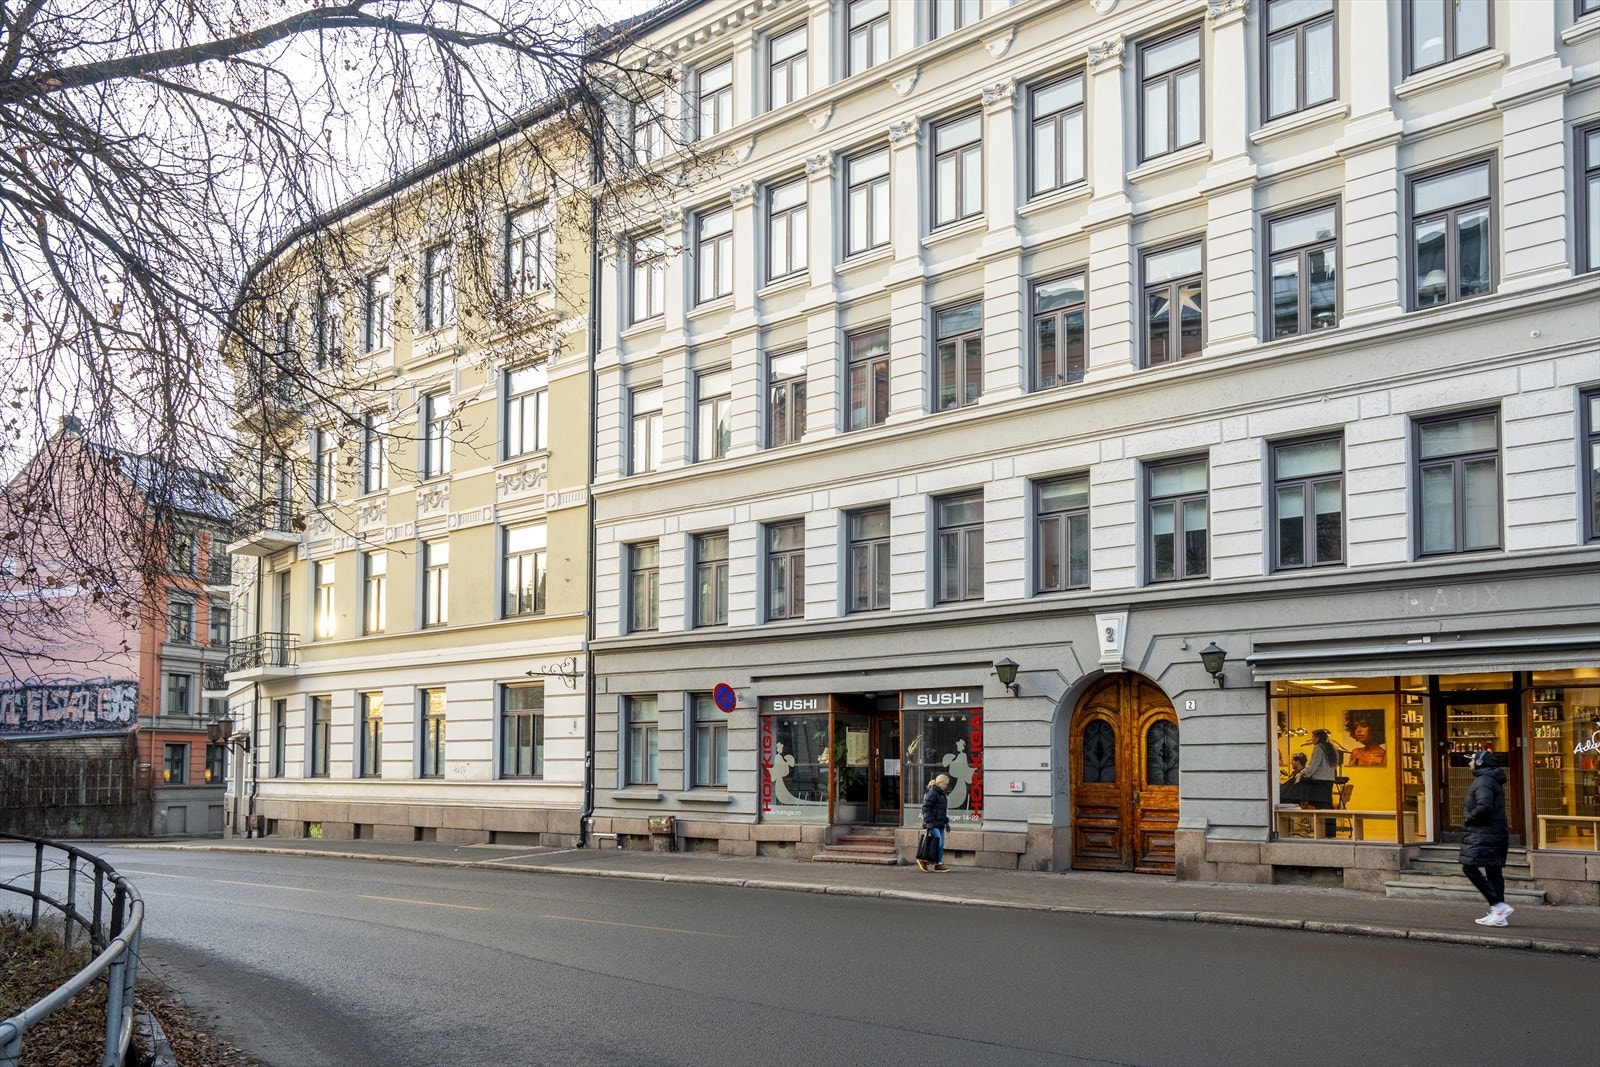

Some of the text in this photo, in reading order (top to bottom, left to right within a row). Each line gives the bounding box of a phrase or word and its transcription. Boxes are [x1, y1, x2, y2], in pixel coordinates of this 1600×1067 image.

[1105, 627, 1114, 642] 2
[773, 698, 817, 711] SUSHI
[917, 692, 969, 706] SUSHI
